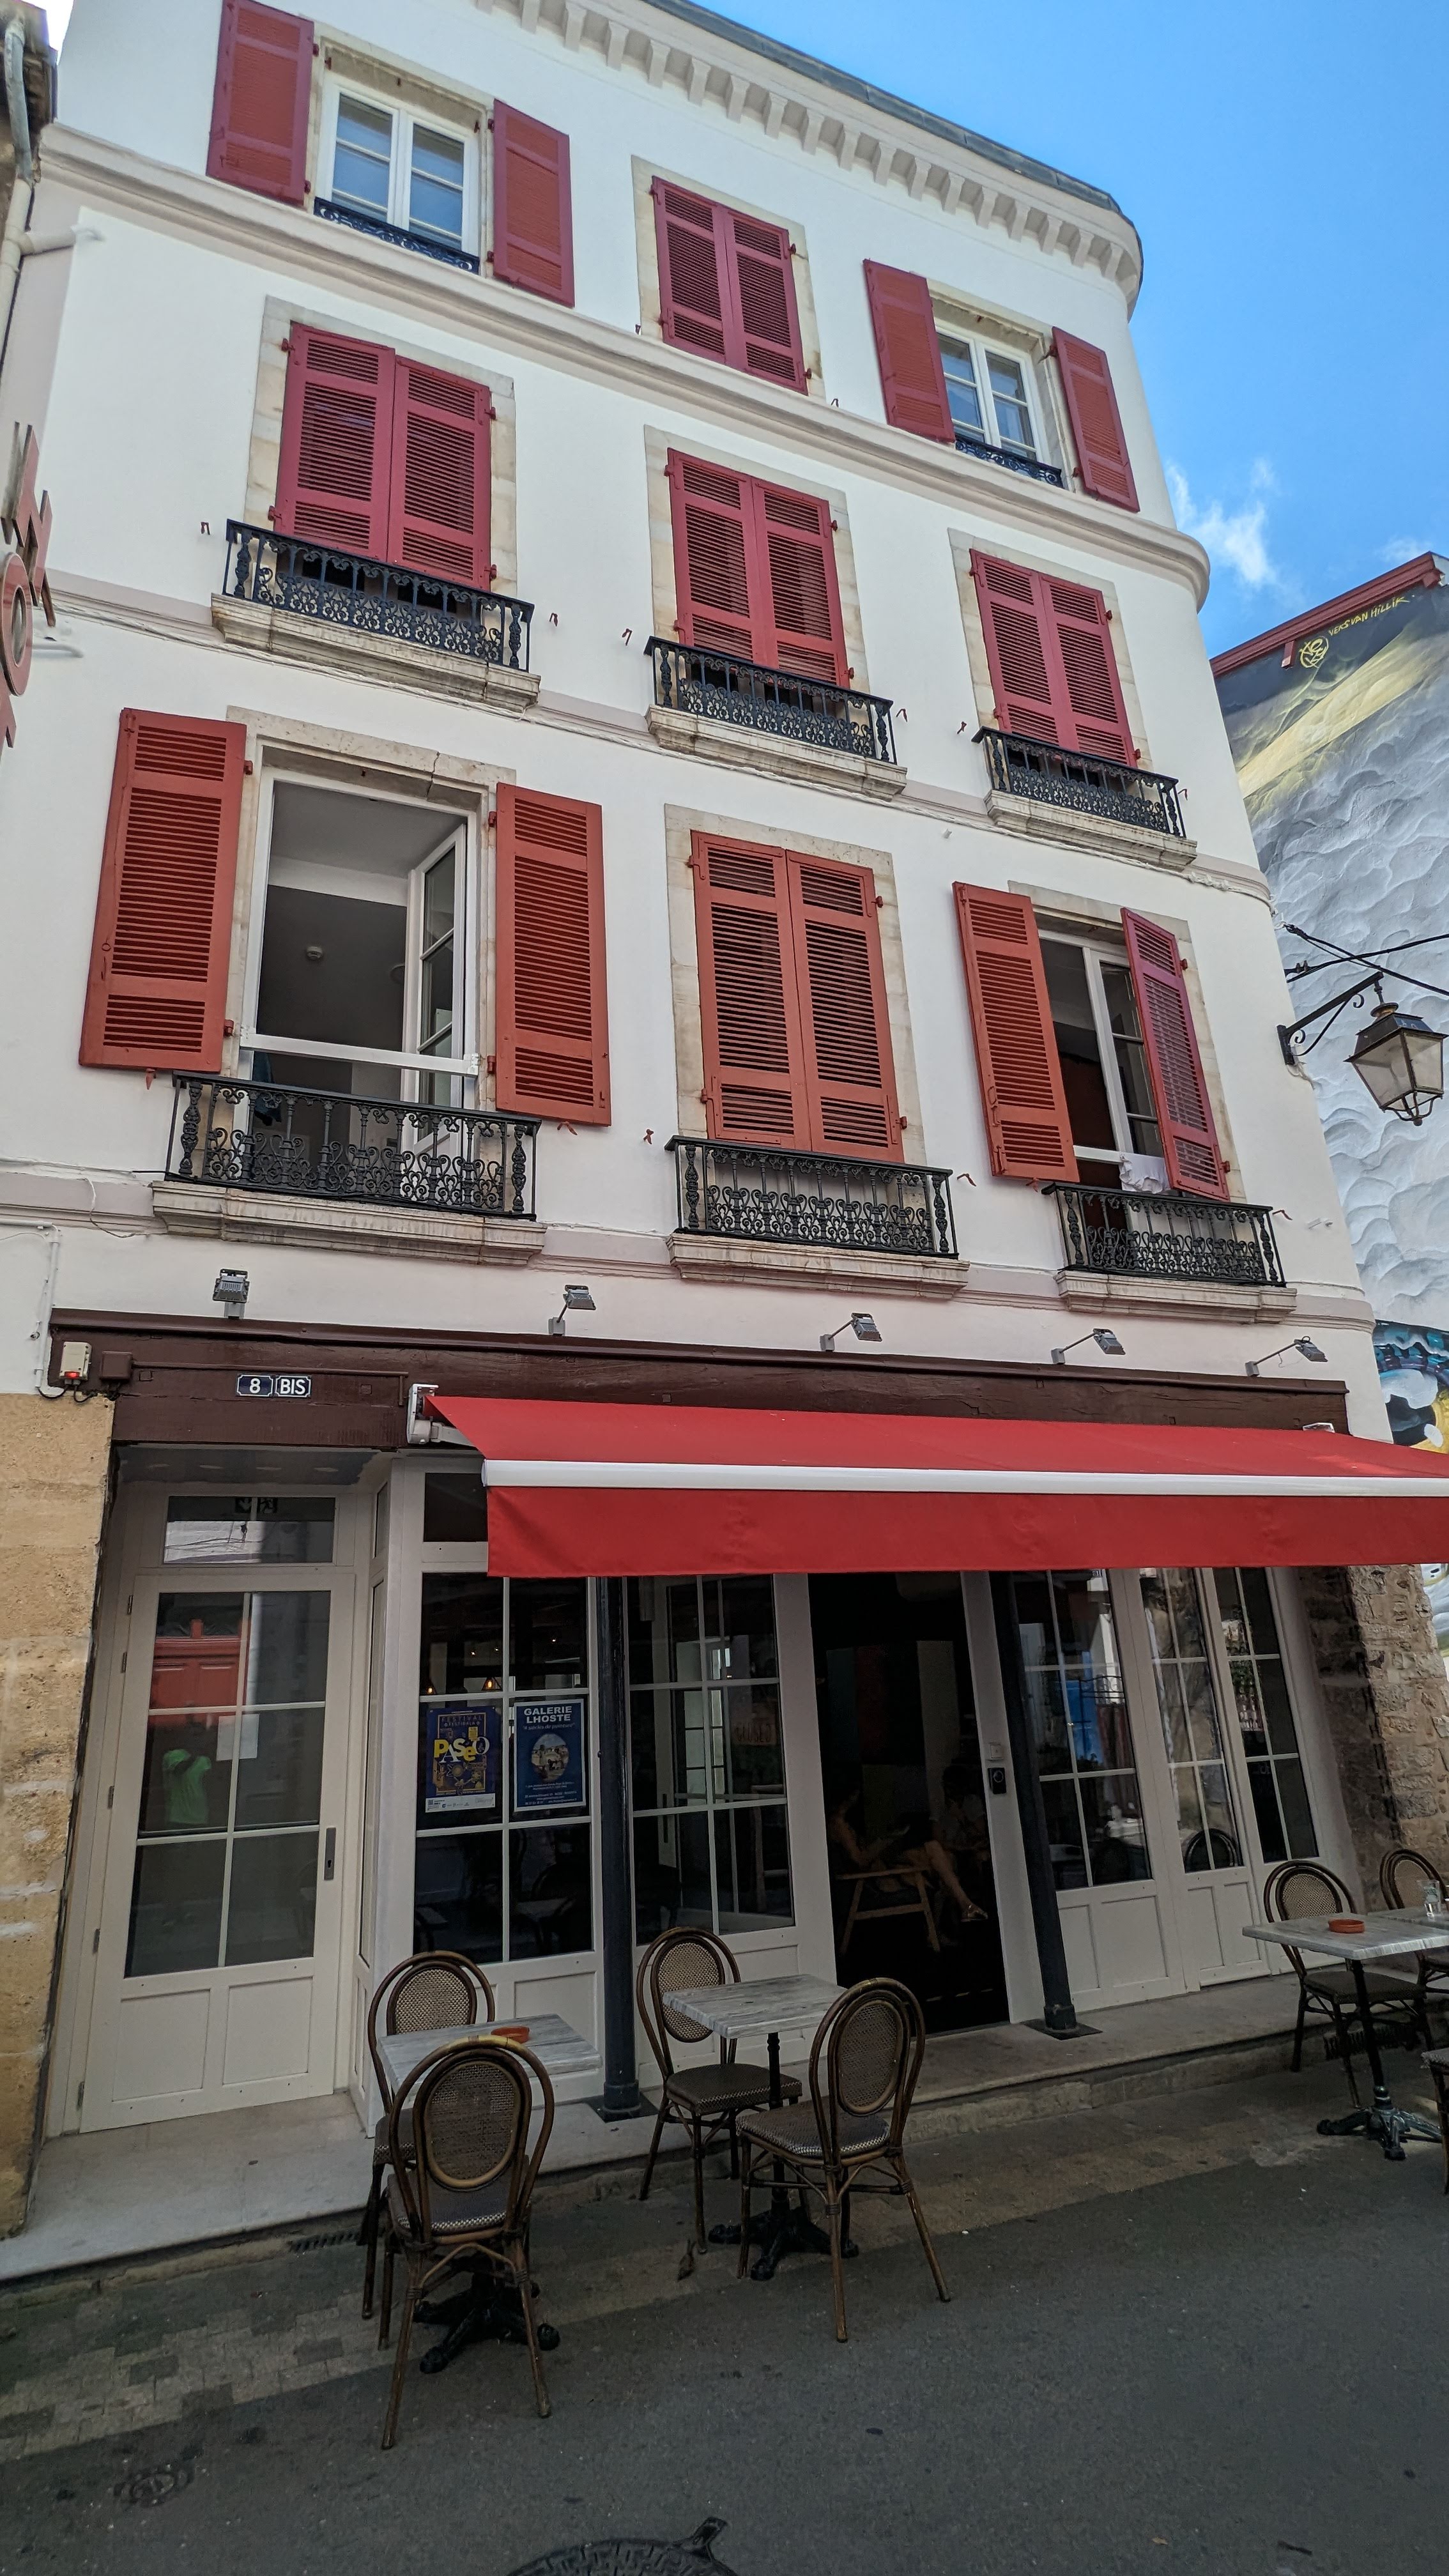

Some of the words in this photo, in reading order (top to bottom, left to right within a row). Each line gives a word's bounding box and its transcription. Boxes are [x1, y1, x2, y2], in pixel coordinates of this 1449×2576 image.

[249, 1377, 261, 1393] 8
[280, 1379, 306, 1395] BIS
[524, 1706, 572, 1716] GALERIE
[441, 1715, 482, 1723] FESTIVAL
[526, 1713, 571, 1724] LHOSTE
